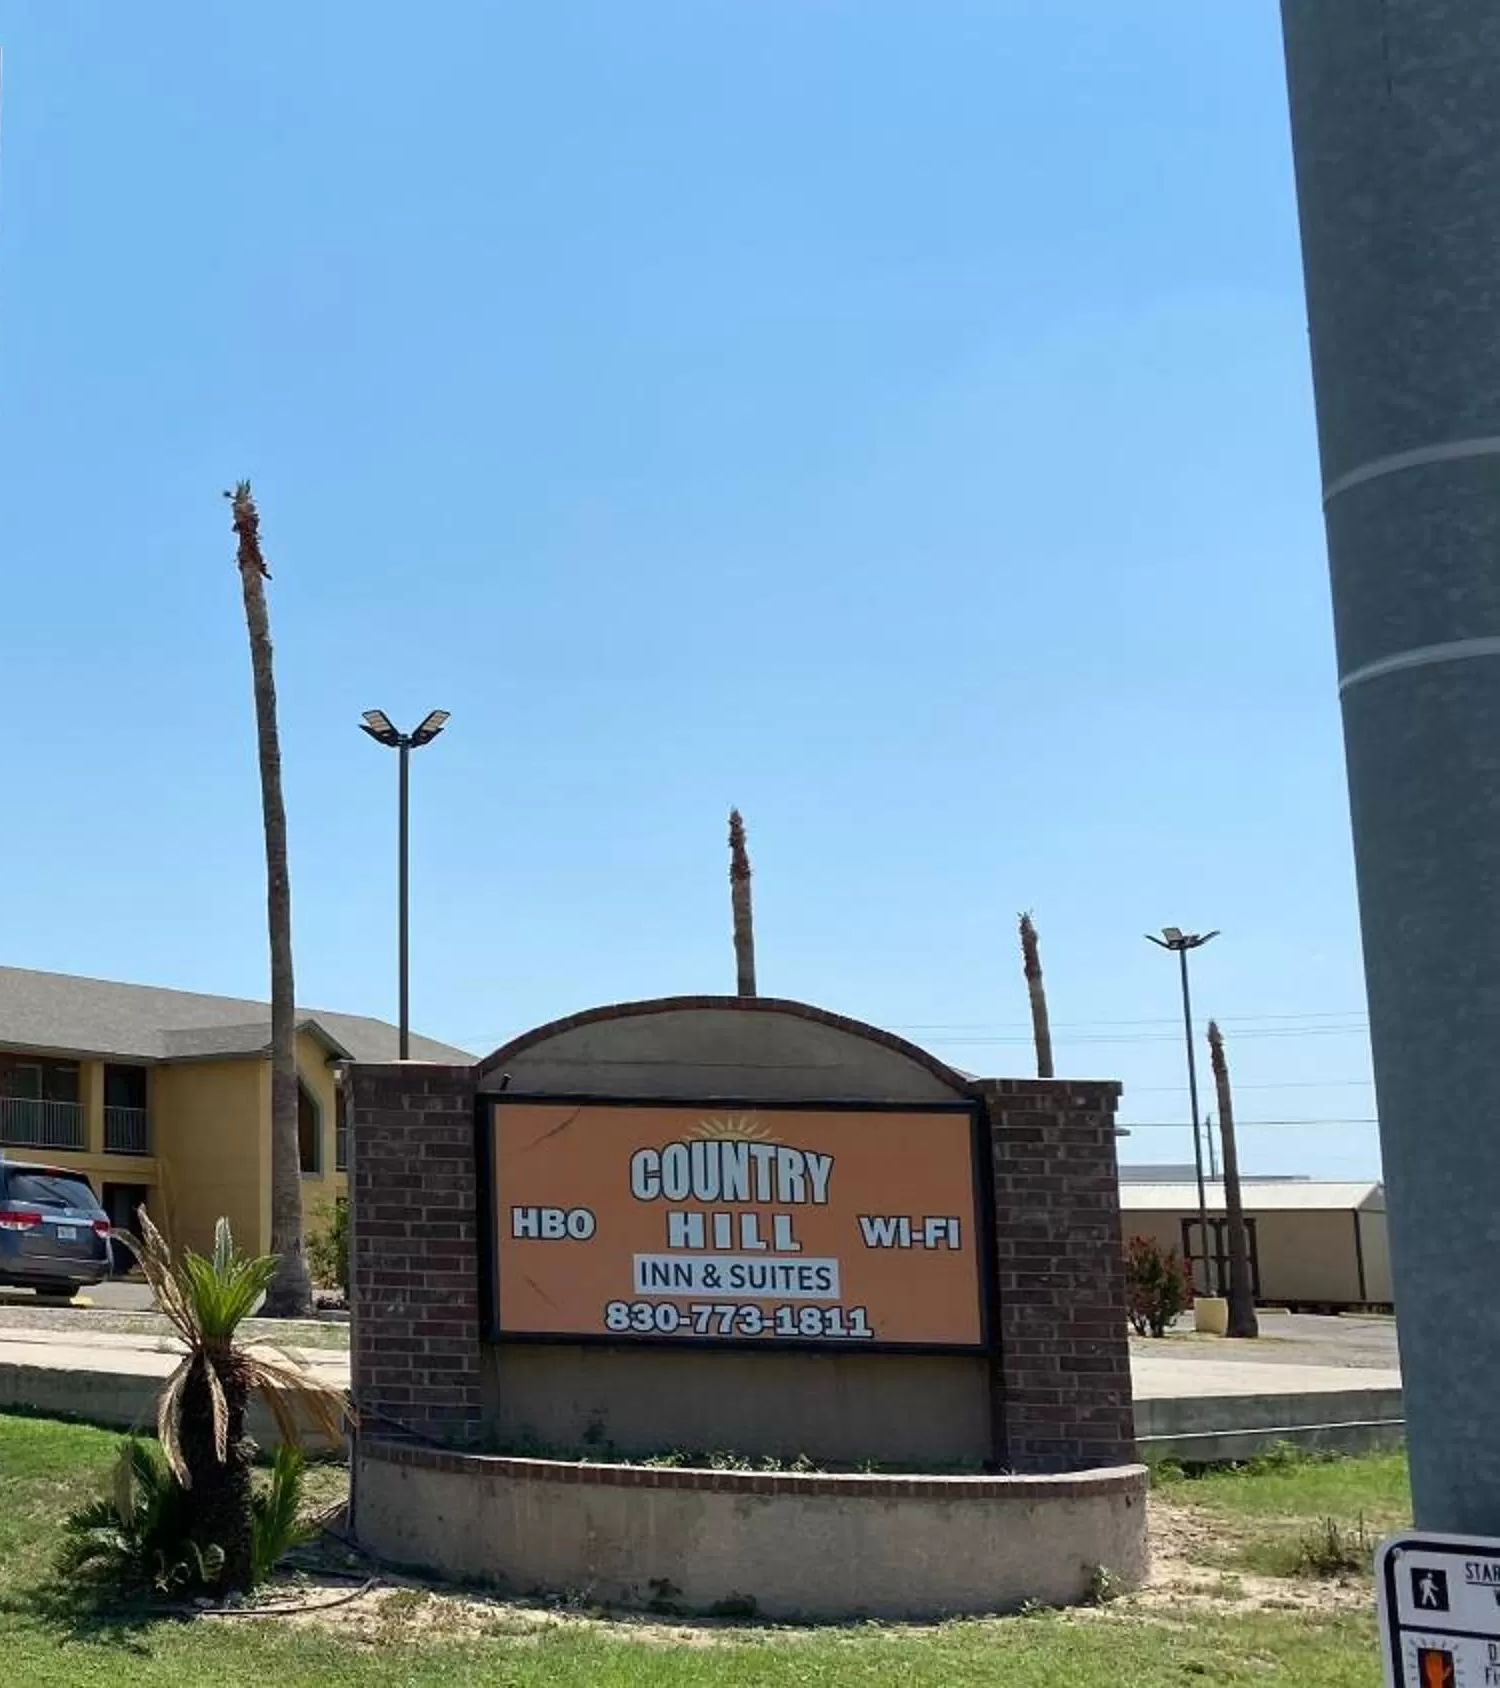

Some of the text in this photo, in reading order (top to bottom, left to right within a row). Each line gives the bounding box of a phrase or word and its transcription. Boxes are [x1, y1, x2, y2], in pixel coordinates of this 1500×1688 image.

[631, 1139, 834, 1203] COUNTRY
[511, 1205, 597, 1241] HBO
[667, 1211, 802, 1252] HILL
[859, 1215, 961, 1250] WI-FI
[640, 1261, 833, 1292] INN & SUITES
[605, 1301, 874, 1339] 830-773-1811
